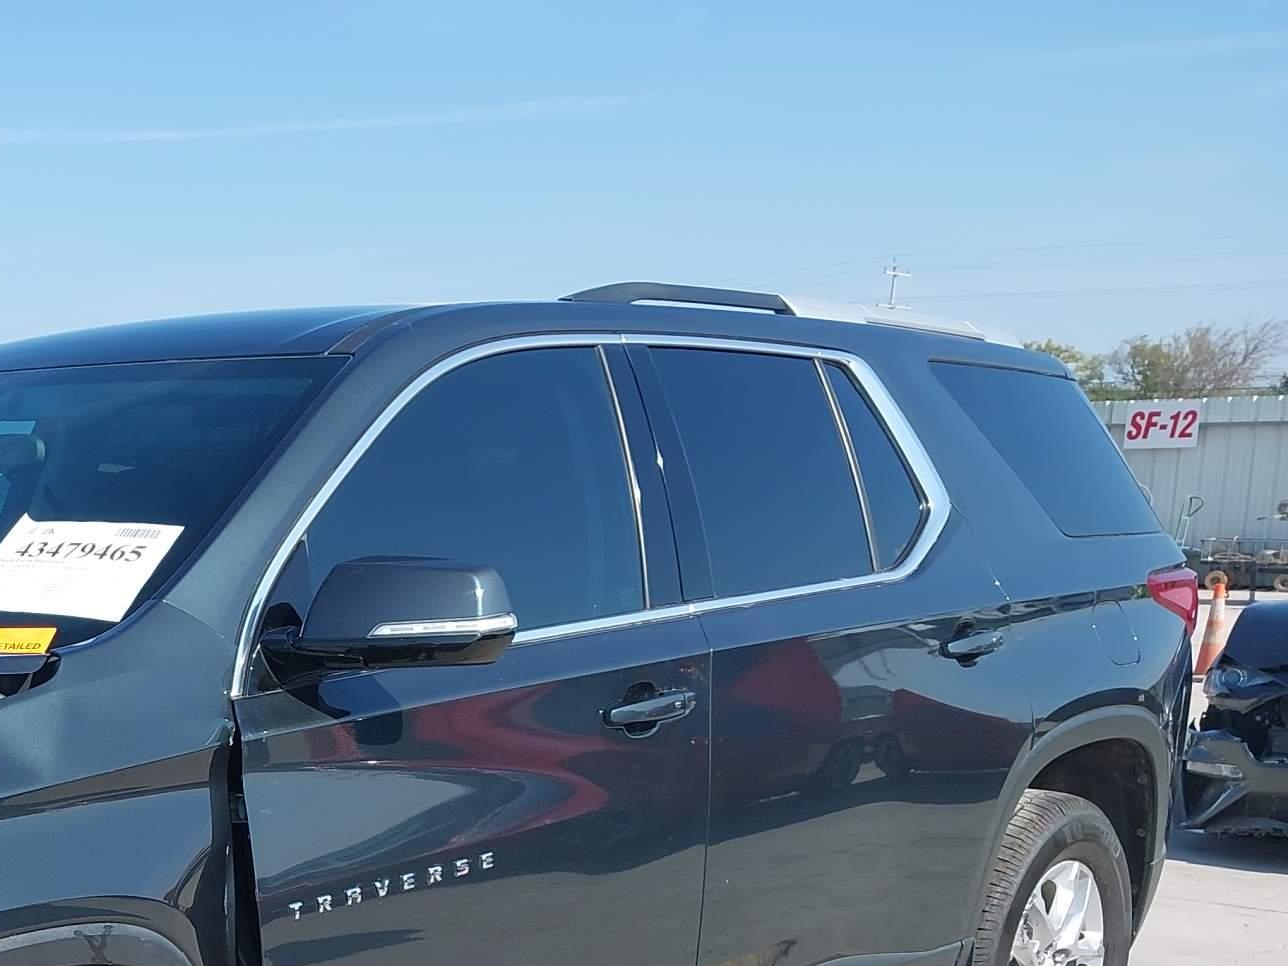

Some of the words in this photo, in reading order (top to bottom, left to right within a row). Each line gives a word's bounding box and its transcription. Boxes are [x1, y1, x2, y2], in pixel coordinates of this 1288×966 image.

[1126, 409, 1198, 440] SF-12
[15, 541, 148, 563] 43479465
[289, 851, 495, 921] TRAVERSE
